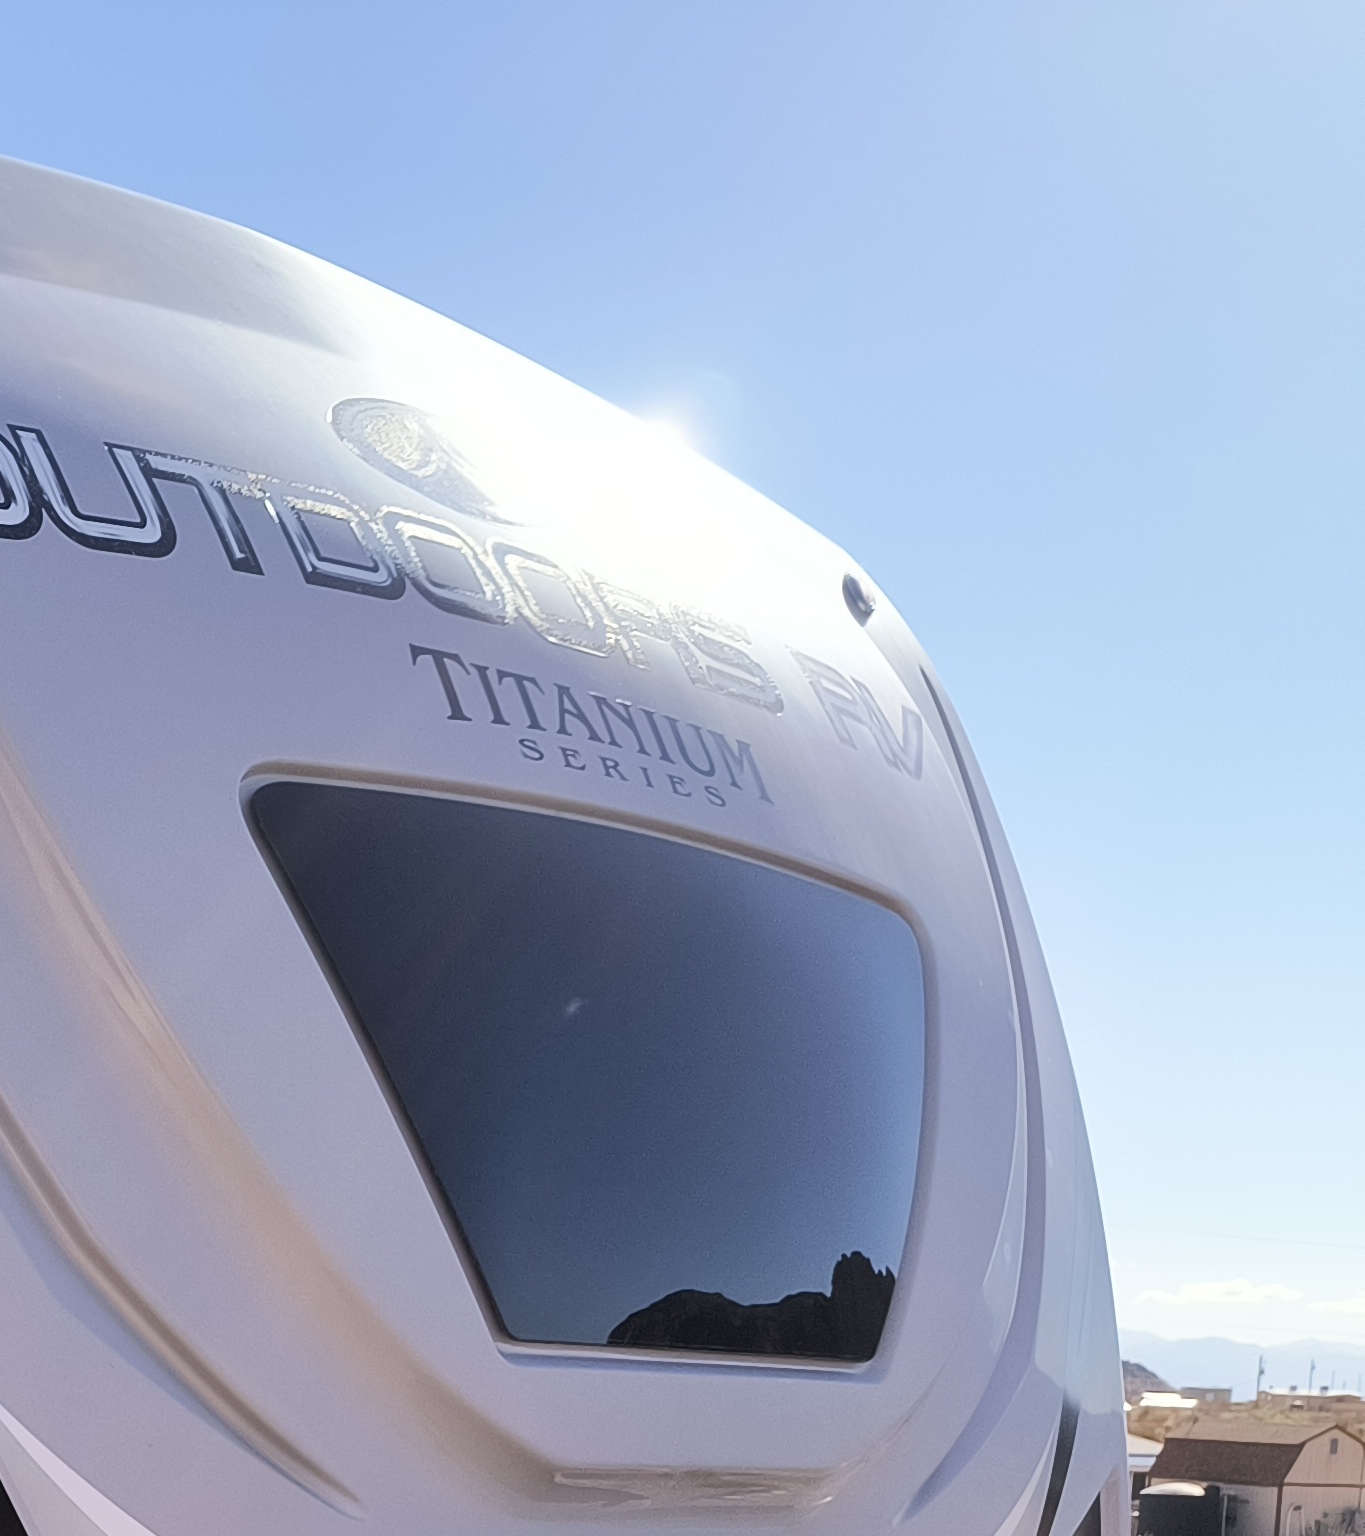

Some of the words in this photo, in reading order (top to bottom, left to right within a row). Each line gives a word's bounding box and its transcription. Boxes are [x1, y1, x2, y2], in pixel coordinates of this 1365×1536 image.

[408, 643, 775, 804] TITANIUM
[519, 738, 727, 807] SERIES
[785, 645, 925, 780] RV
